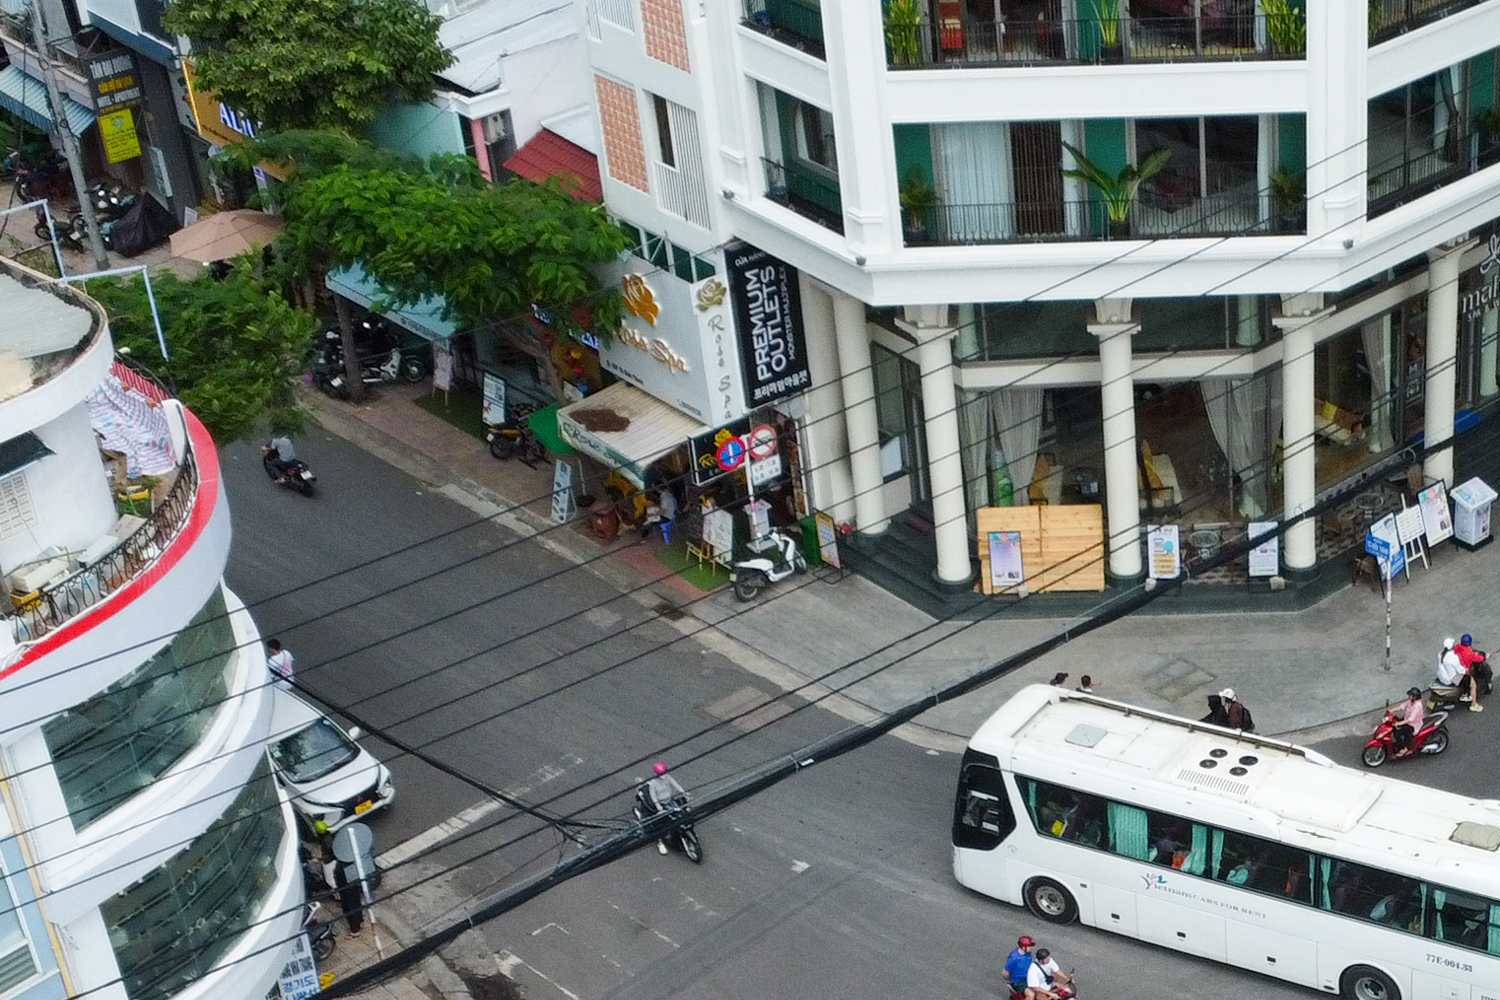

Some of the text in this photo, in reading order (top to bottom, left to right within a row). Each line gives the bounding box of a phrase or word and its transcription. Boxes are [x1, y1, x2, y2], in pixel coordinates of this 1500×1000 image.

[651, 337, 692, 375] Spa
[744, 267, 773, 381] PREMIUM
[760, 265, 787, 372] OUTLETS
